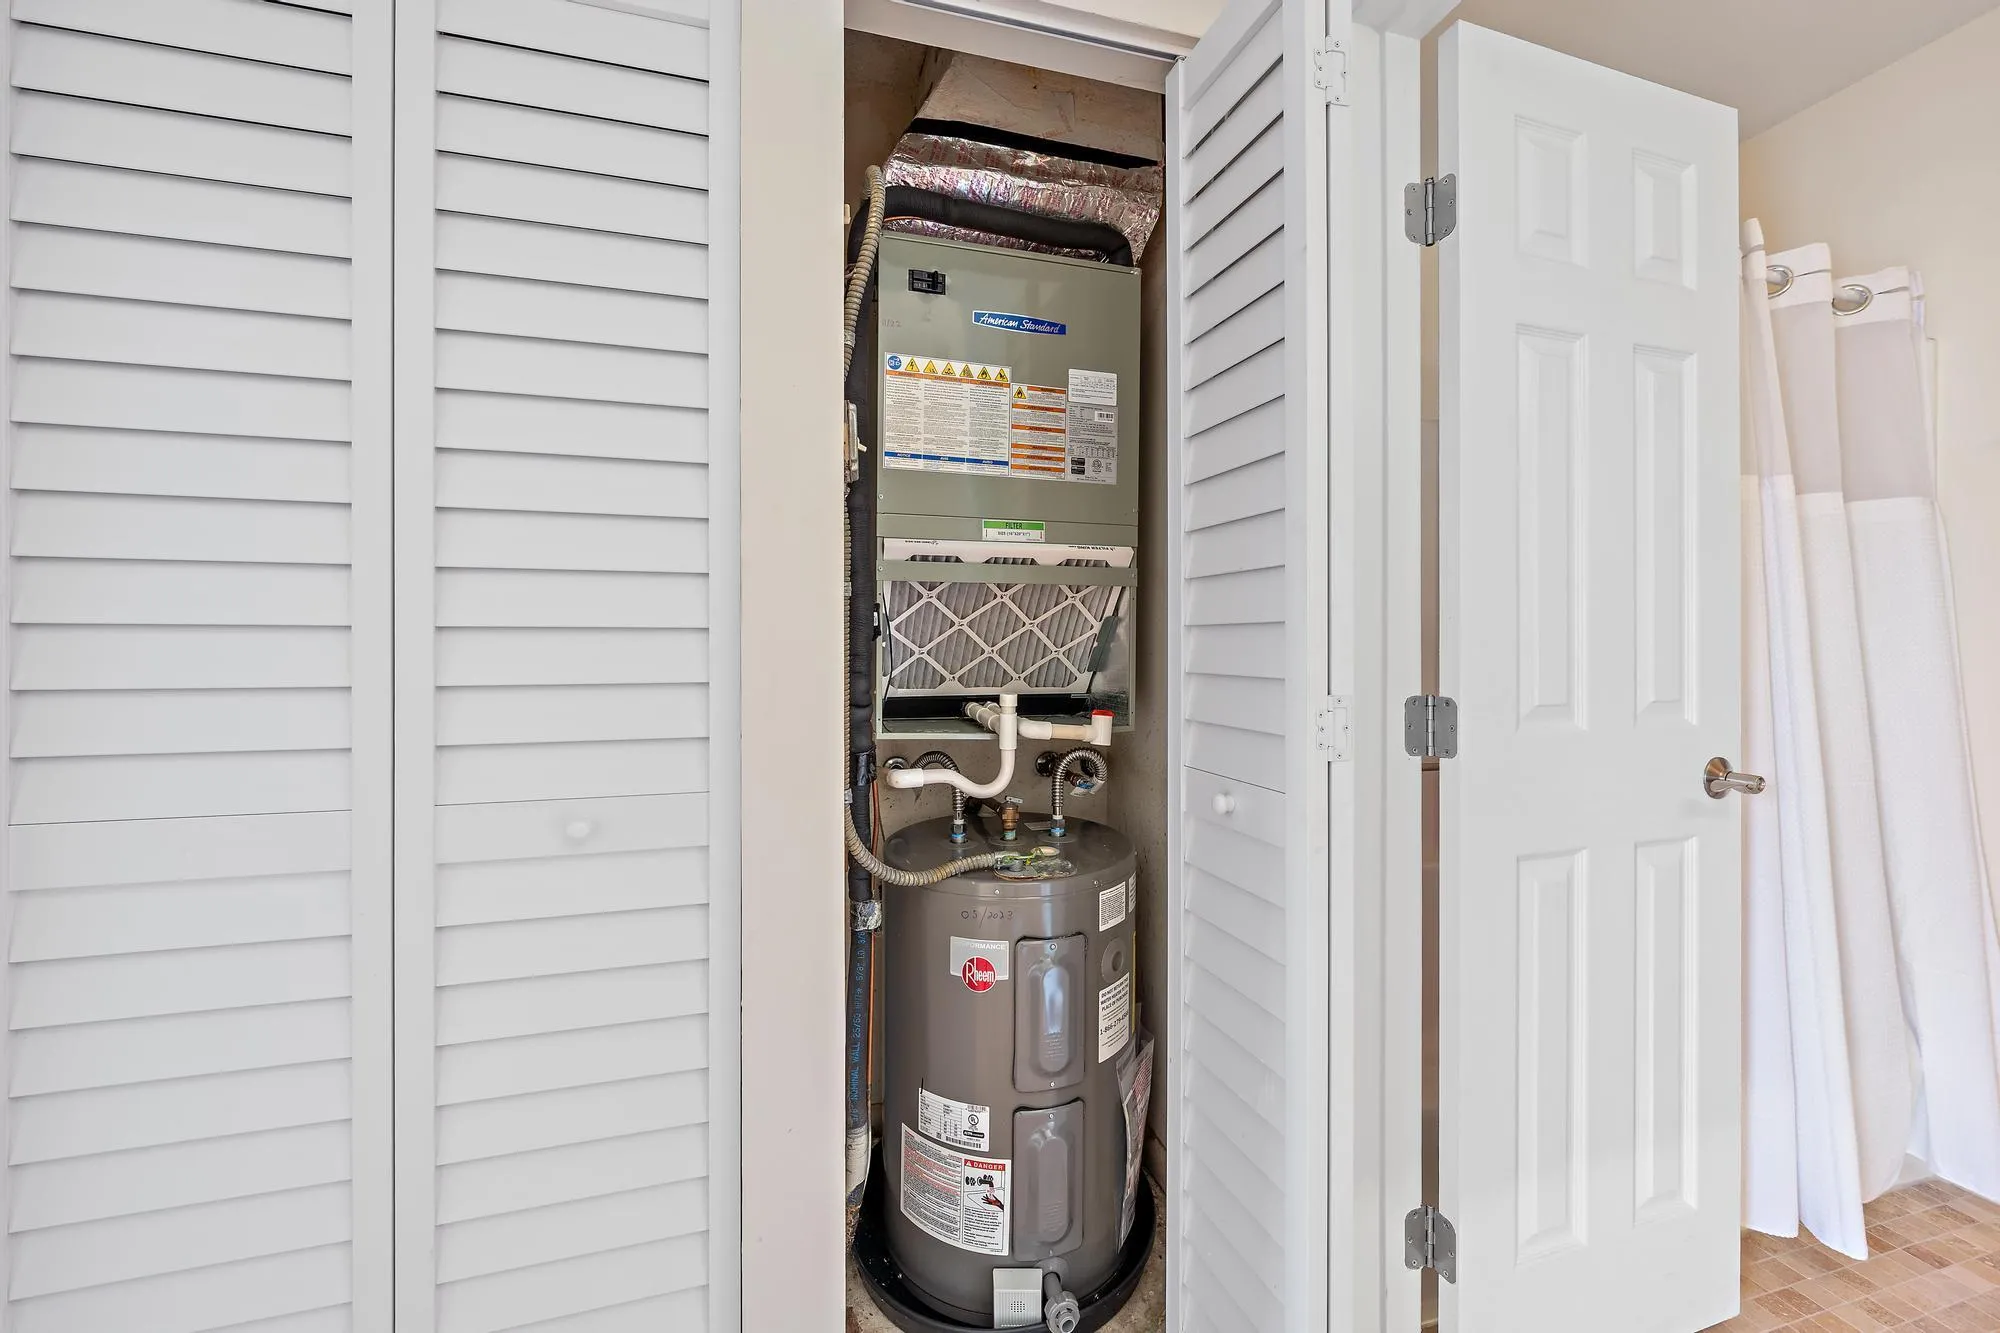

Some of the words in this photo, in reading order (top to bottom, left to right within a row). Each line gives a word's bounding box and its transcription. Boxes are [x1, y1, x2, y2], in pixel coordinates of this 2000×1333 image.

[979, 313, 1018, 328] American
[1020, 320, 1060, 333] Standard
[965, 956, 995, 987] Rheem
[852, 1042, 860, 1063] WALL
[851, 1066, 859, 1100] NOMINAL
